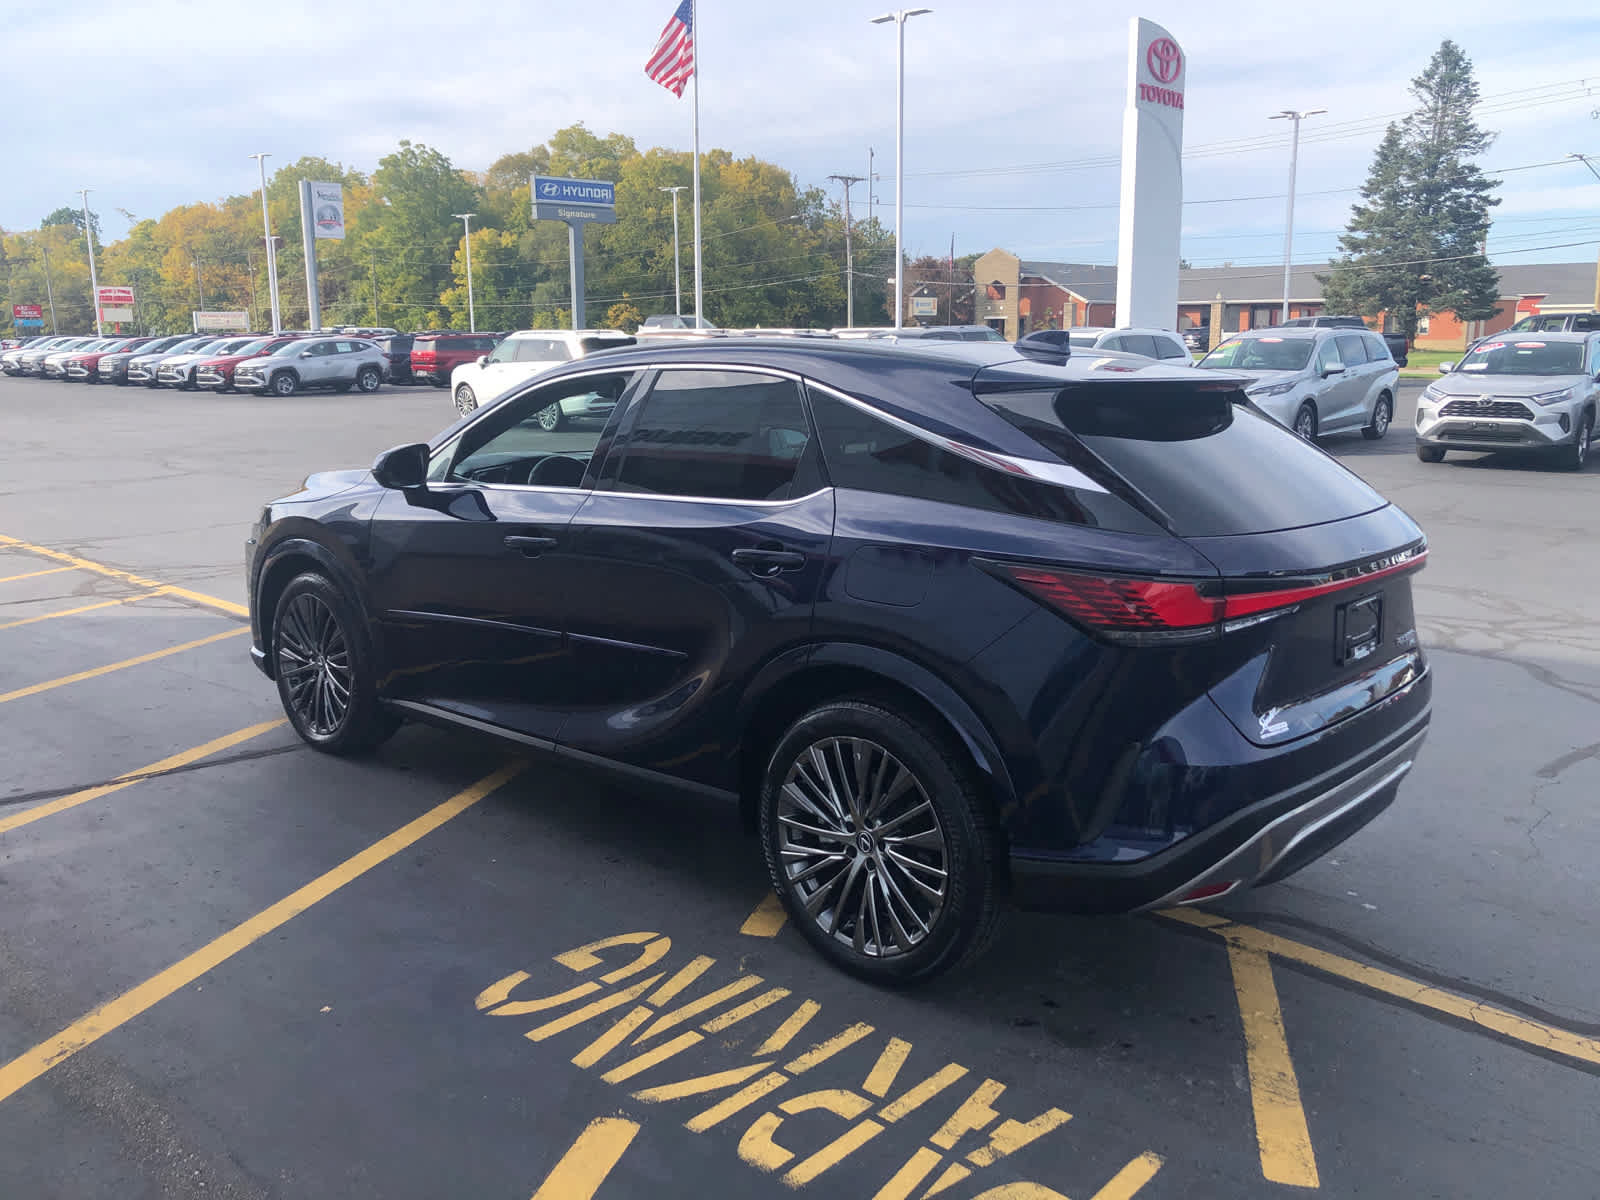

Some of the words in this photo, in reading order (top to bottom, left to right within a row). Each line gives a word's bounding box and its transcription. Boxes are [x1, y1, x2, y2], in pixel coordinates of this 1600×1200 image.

[1139, 84, 1184, 109] TOYOTA
[563, 185, 612, 200] HYUNDAI
[558, 208, 596, 219] Signature
